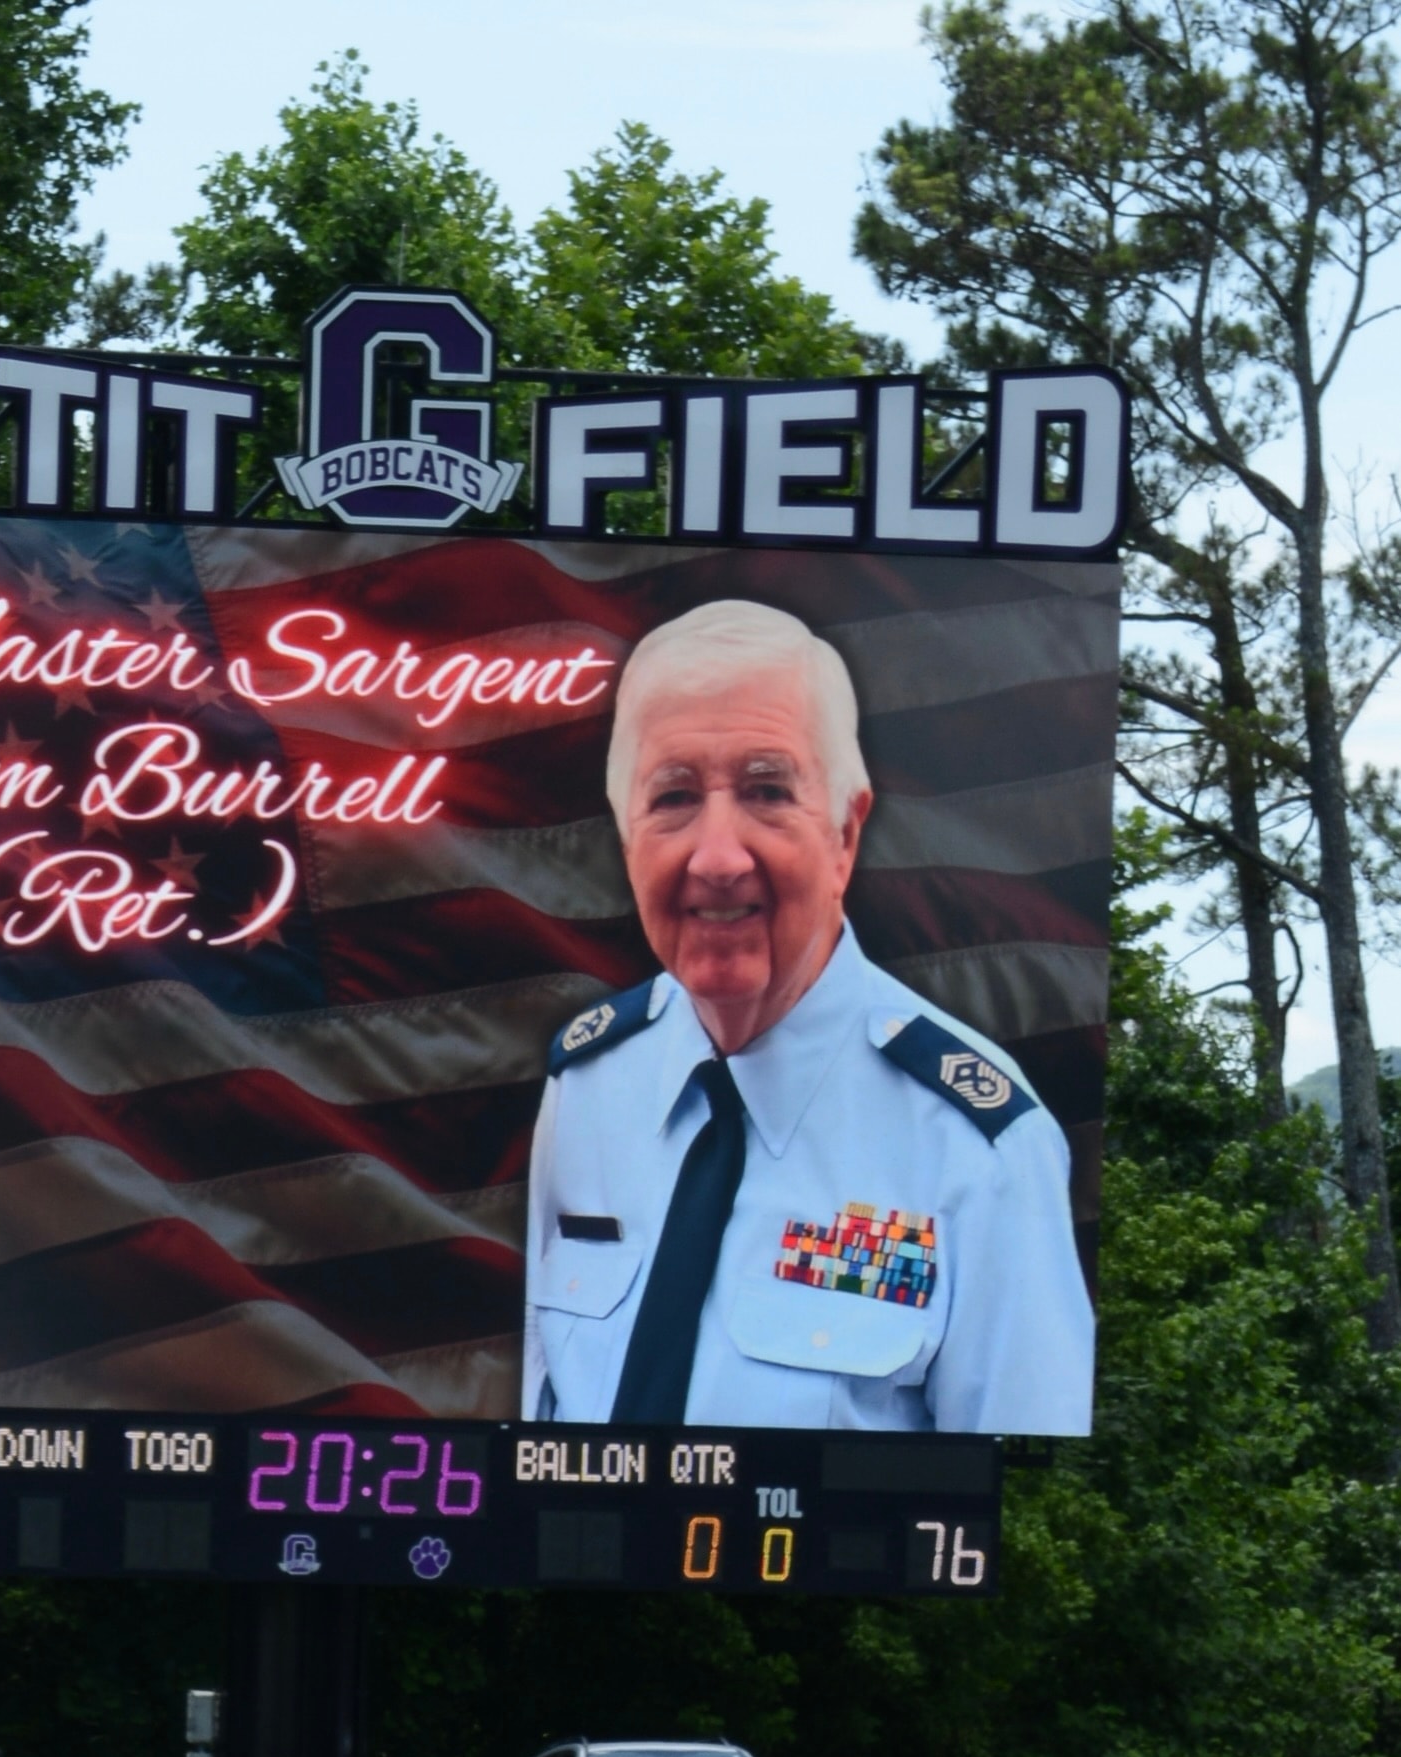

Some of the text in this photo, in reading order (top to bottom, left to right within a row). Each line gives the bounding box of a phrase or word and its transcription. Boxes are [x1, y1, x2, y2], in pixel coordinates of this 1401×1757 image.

[307, 288, 495, 531] G
[321, 446, 483, 502] BOBCATS
[545, 373, 1125, 549] FIELD
[227, 608, 616, 729] Sargent
[79, 722, 448, 823] Burrell
[125, 1430, 213, 1472] TOGO
[248, 1431, 482, 1515] 20:26
[670, 1443, 736, 1485] QTR
[755, 1487, 803, 1519] TOL
[682, 1516, 721, 1580] 0
[760, 1527, 794, 1583] 0
[915, 1521, 986, 1587] 76
